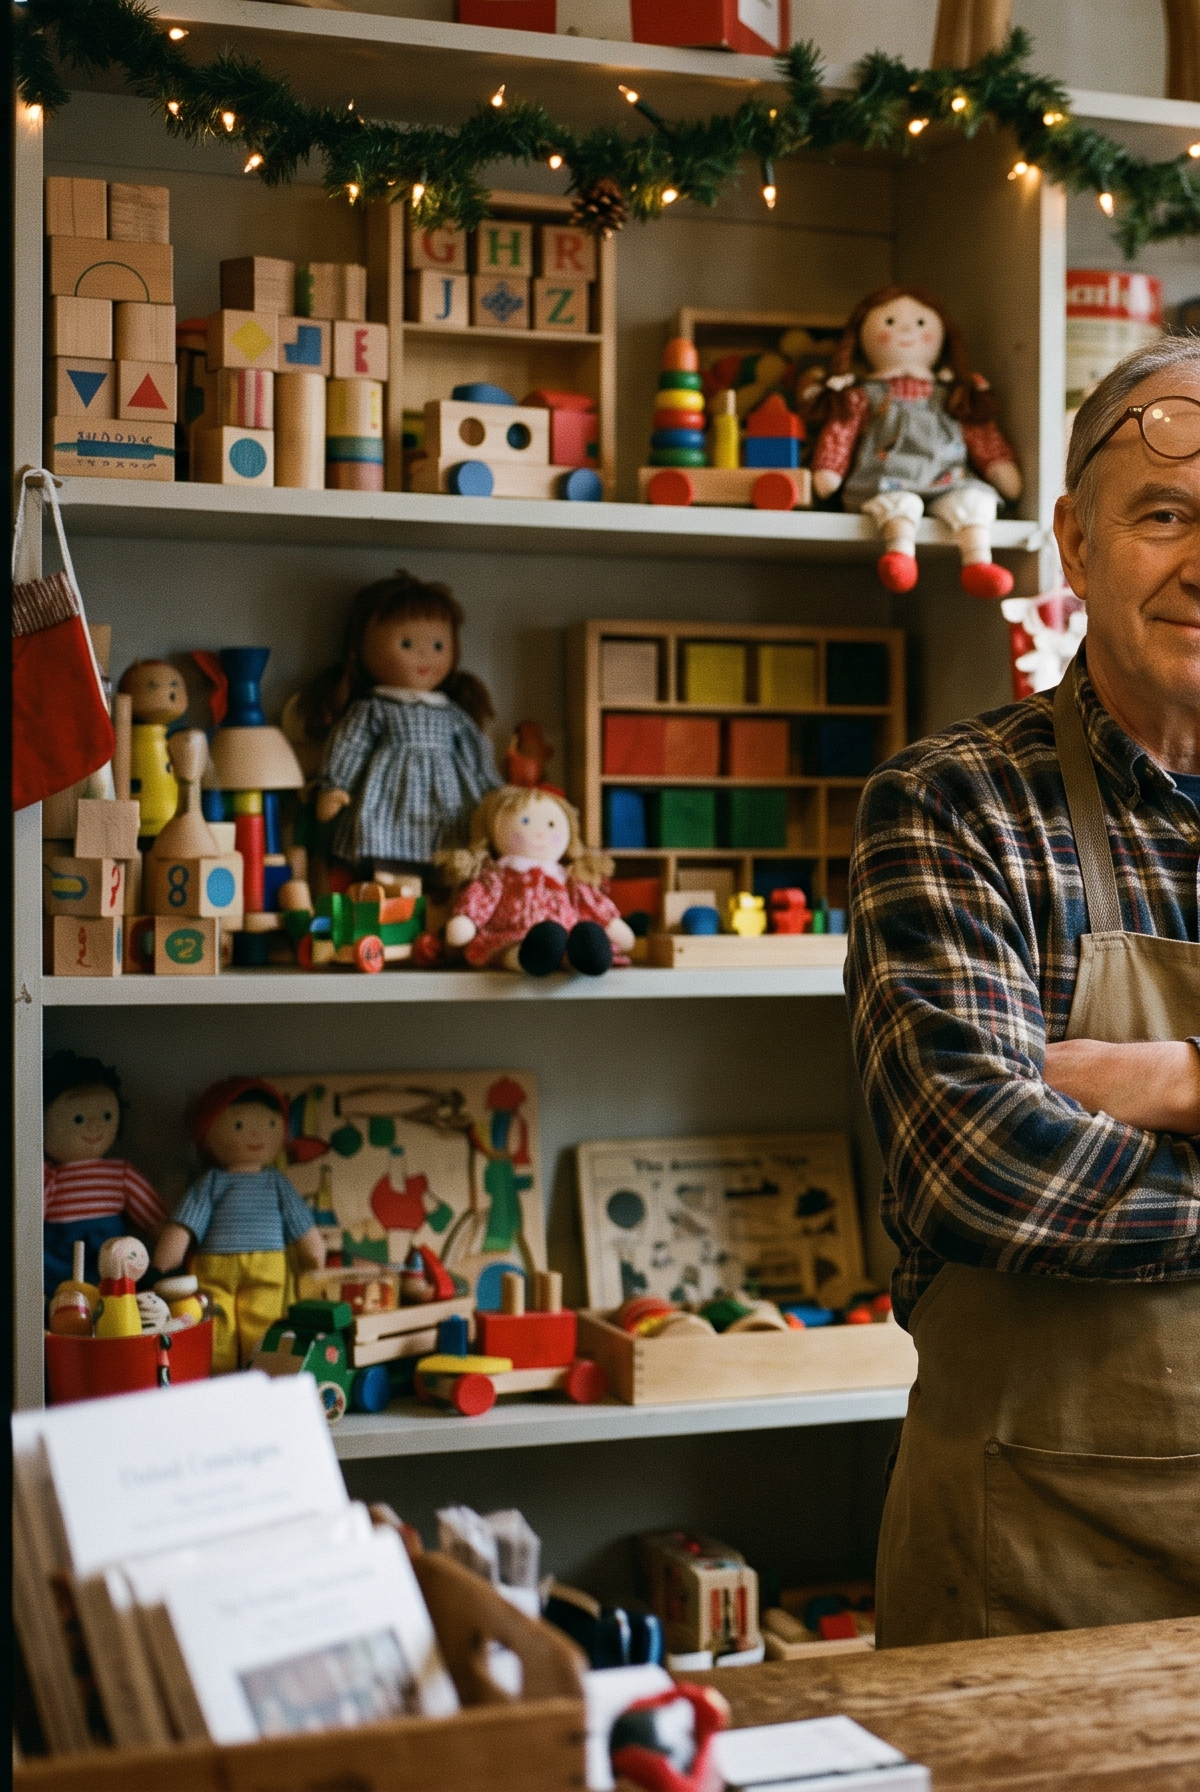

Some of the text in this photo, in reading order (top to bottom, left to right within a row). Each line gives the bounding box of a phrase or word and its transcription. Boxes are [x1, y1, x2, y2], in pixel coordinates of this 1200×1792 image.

[422, 225, 584, 271] G H R
[436, 277, 454, 320] J
[546, 288, 576, 325] Z
[167, 865, 189, 908] 8
